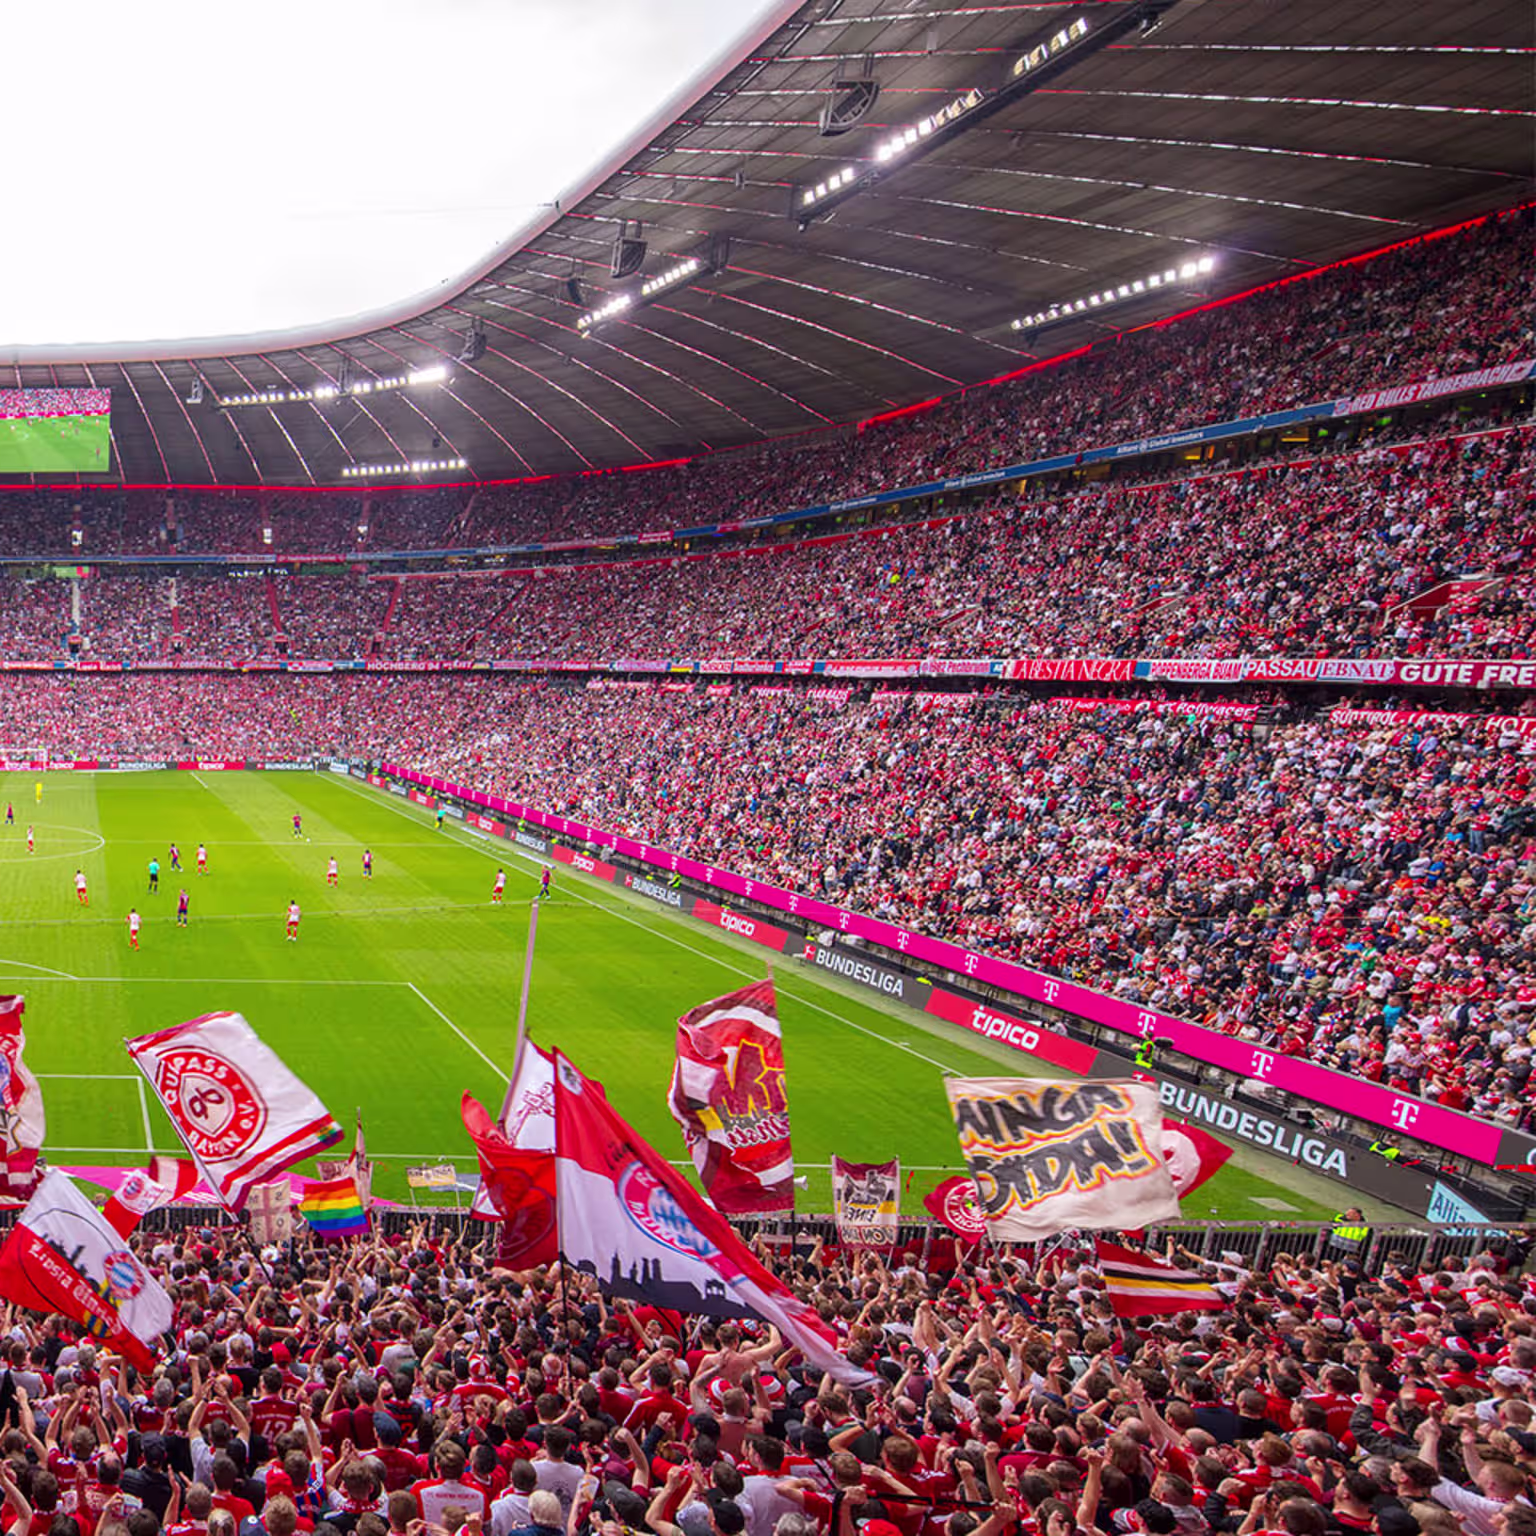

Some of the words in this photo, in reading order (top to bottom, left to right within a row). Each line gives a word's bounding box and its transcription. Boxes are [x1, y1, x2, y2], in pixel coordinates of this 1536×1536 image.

[1376, 384, 1417, 408] BULLS
[1246, 660, 1317, 678] PASSAU
[1399, 663, 1474, 685] GUTE
[1482, 665, 1536, 686] FRE
[118, 761, 167, 770] BUNDESLIGA
[264, 761, 314, 771] BUNDESLIGA
[571, 851, 595, 873] tipico
[631, 878, 682, 907] BUNDESLIGA
[719, 908, 756, 937] tipico
[814, 948, 904, 998] BUNDESLIGA
[971, 1005, 1040, 1050] tipico
[1158, 1080, 1348, 1178] BUNDESLIGA
